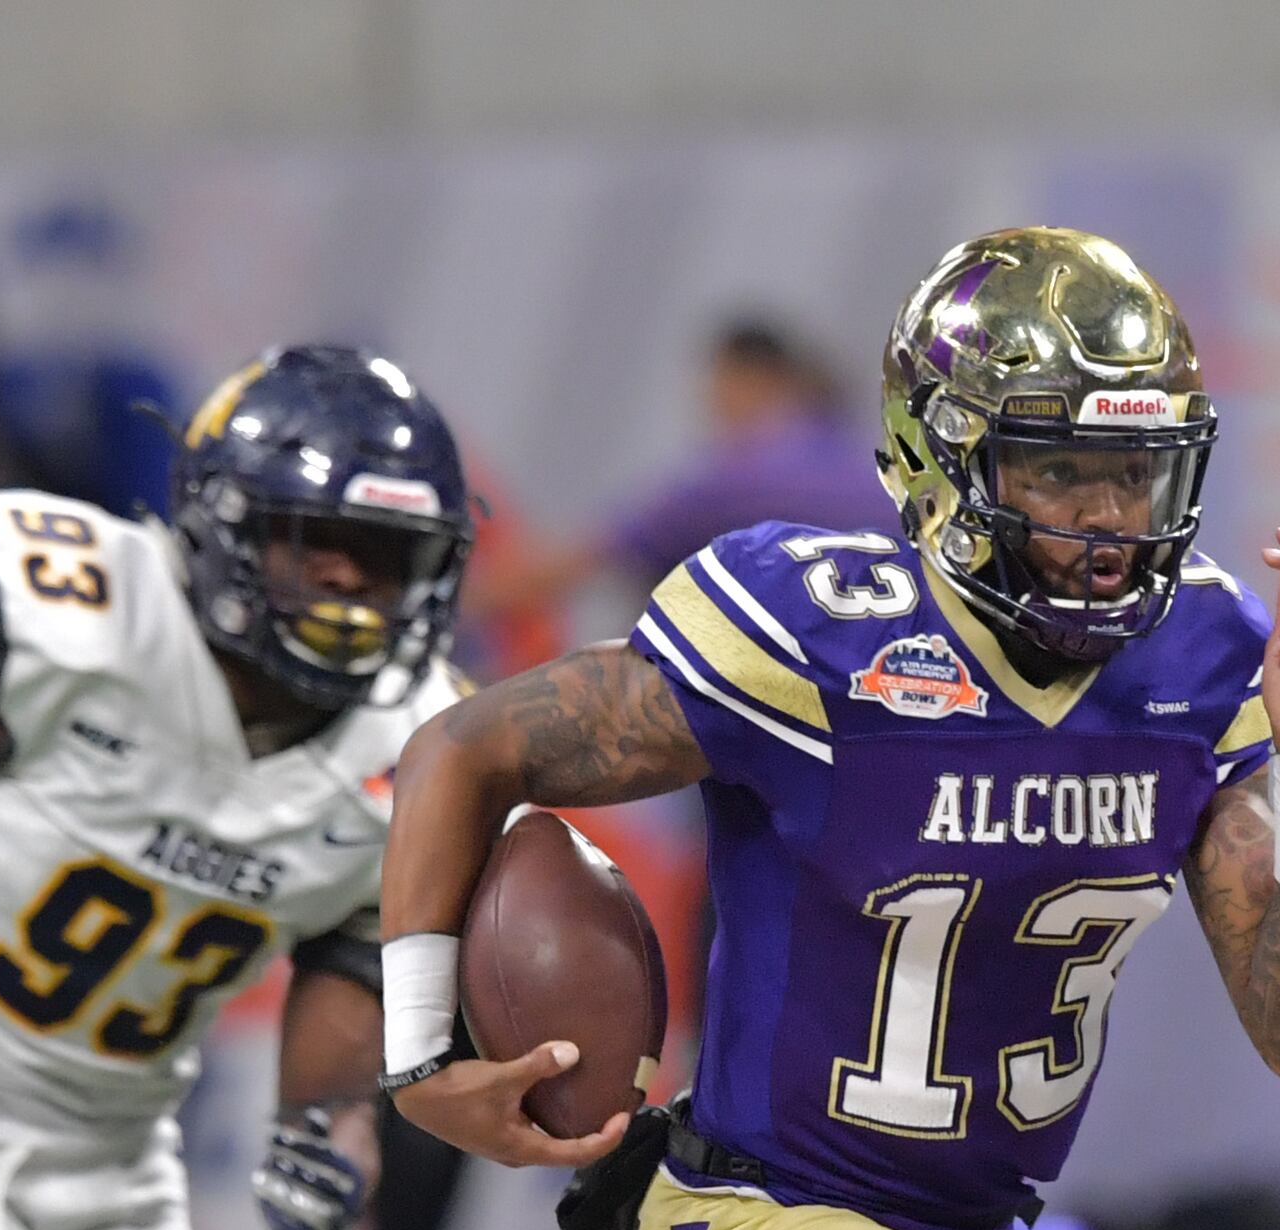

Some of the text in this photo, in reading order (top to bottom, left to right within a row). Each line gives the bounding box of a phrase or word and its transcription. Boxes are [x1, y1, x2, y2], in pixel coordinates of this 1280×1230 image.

[1006, 401, 1063, 416] ALCORN
[10, 508, 109, 613] 93
[778, 532, 920, 620] 13
[900, 660, 958, 675] AIR FORCE
[900, 691, 937, 704] BOWL
[1156, 701, 1190, 714] SWAC
[919, 772, 1159, 847] ALCORN
[142, 823, 287, 901] AGGIES
[828, 872, 1177, 1139] 13
